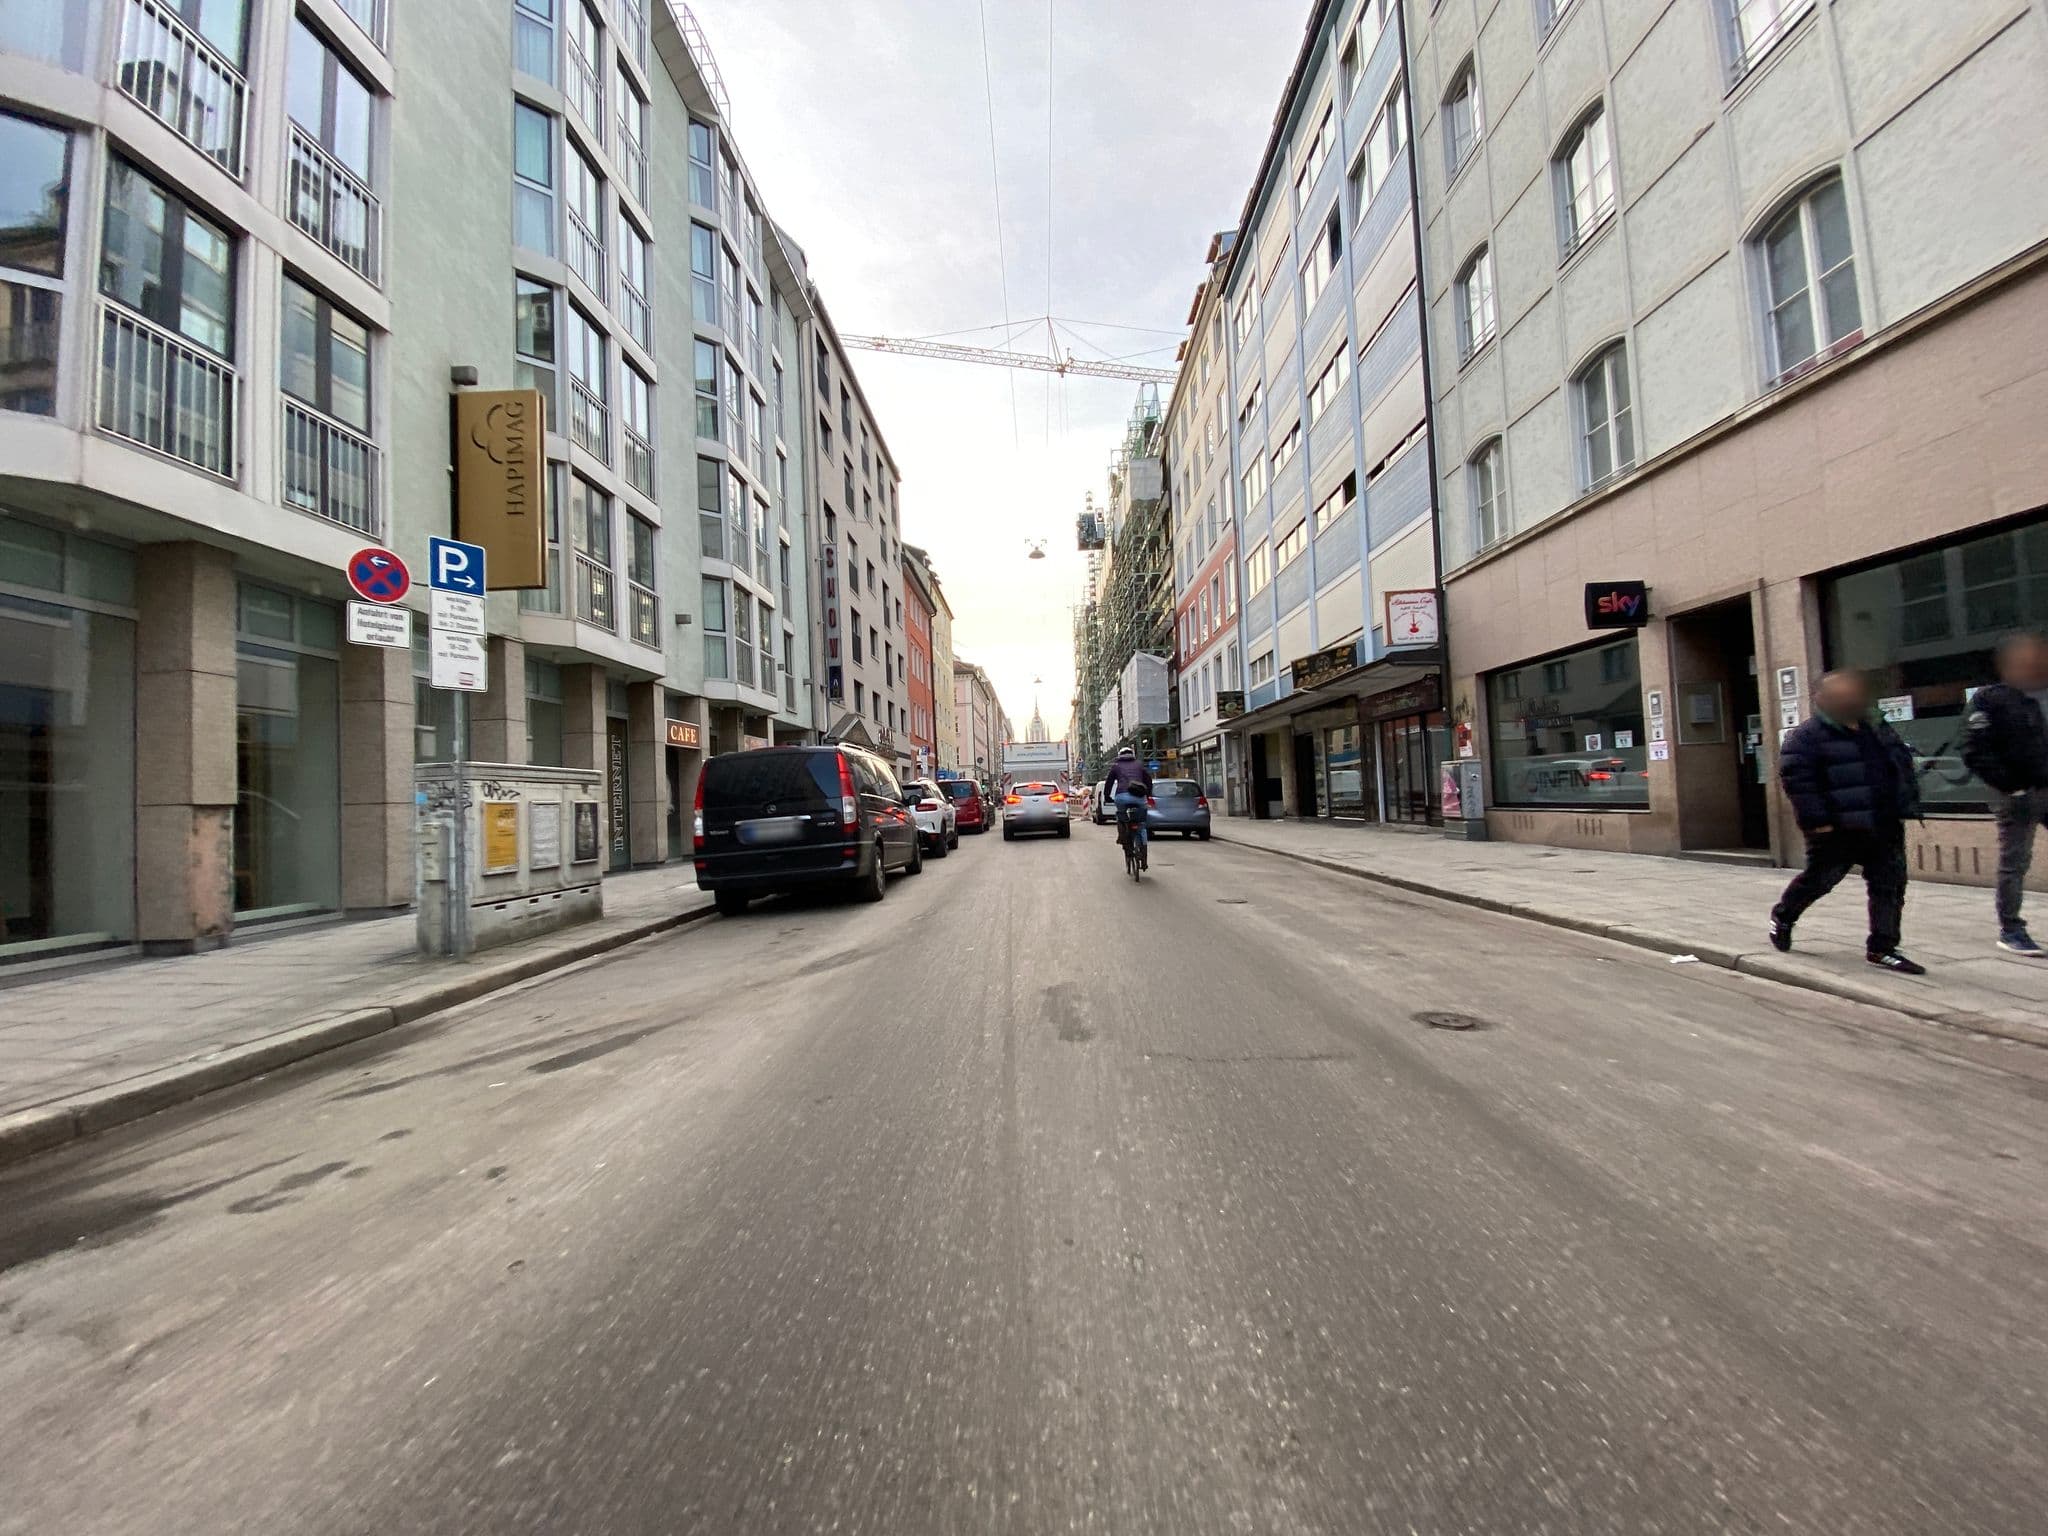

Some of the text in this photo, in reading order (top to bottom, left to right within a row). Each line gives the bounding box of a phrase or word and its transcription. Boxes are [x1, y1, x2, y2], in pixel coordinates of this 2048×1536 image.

[505, 401, 525, 516] HAPIMAG
[438, 544, 469, 584] P
[1597, 591, 1641, 617] sky
[670, 724, 697, 744] CAFE
[611, 734, 624, 852] INTERNET
